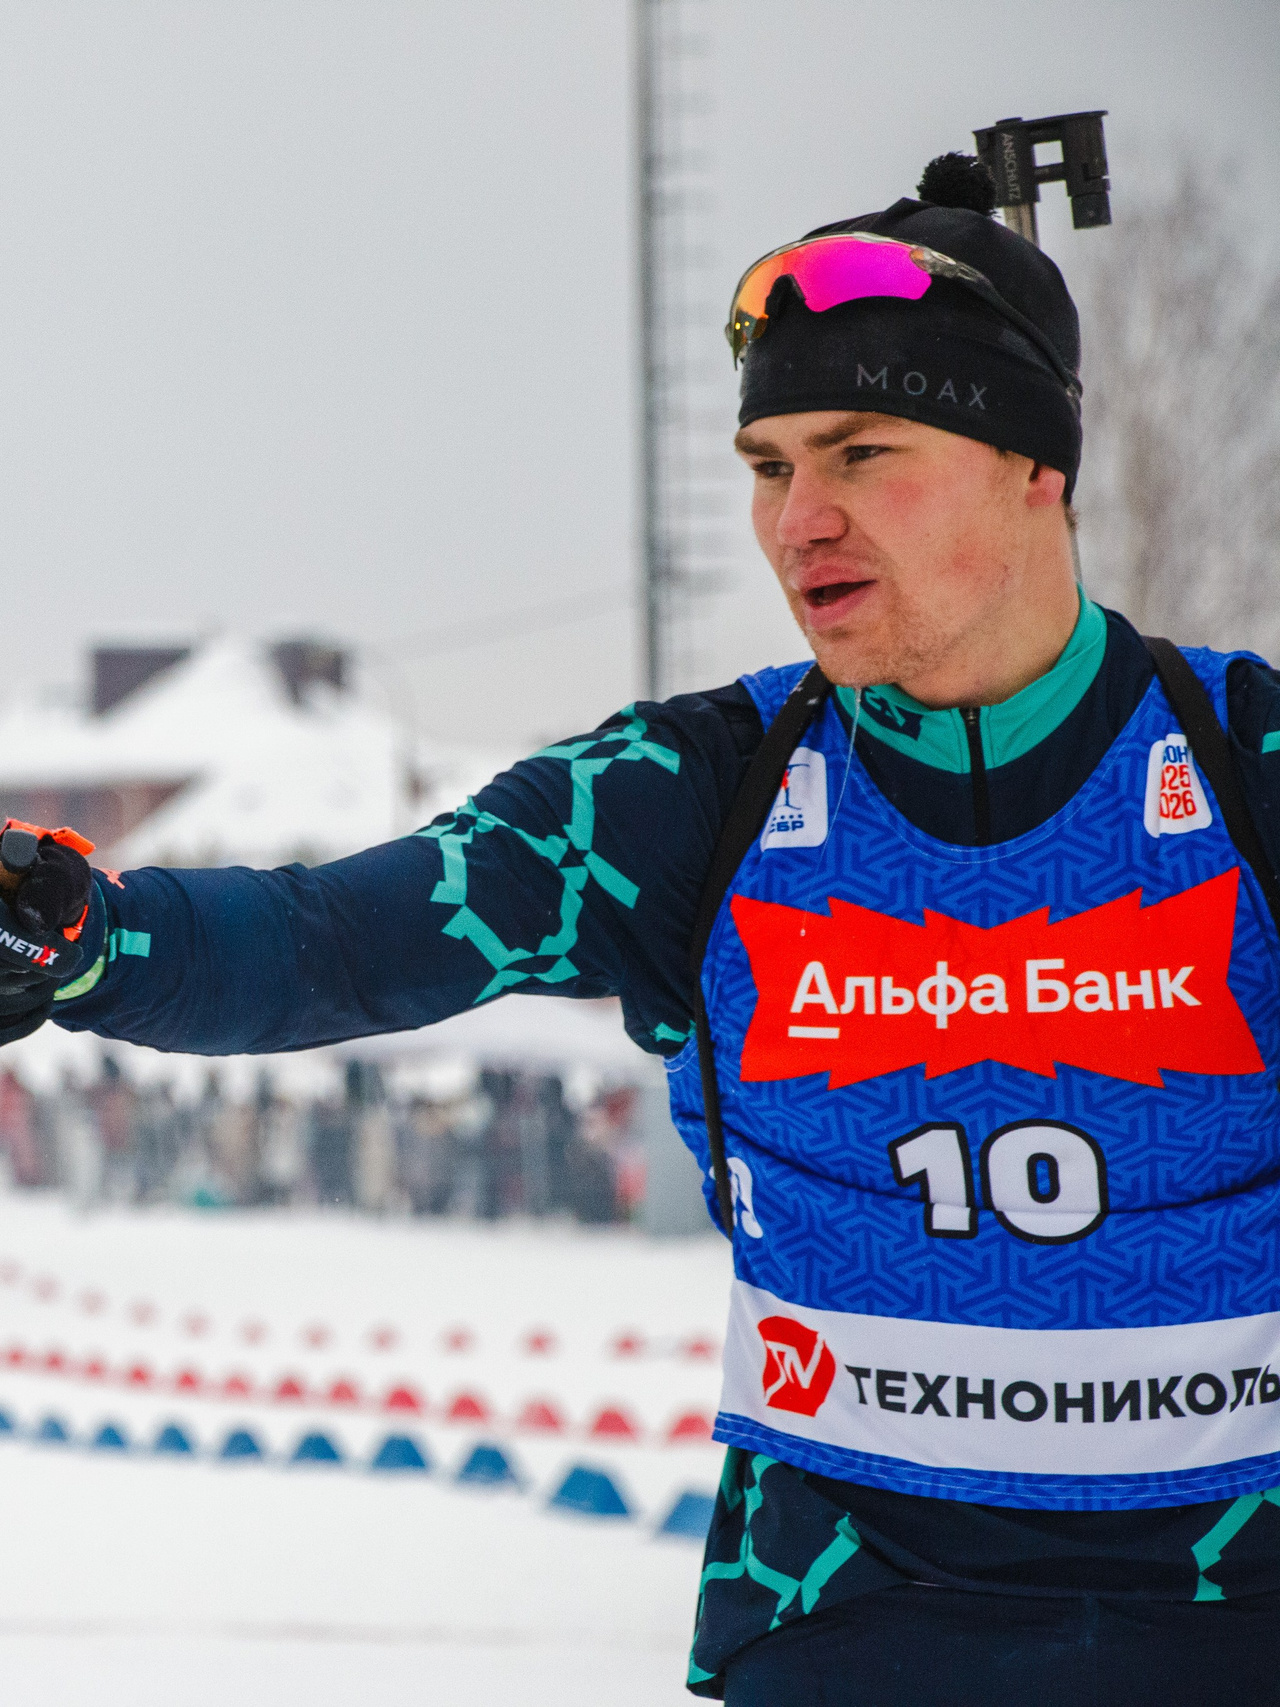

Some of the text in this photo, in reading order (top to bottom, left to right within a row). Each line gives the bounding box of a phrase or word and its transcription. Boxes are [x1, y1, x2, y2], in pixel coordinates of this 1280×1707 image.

[856, 363, 987, 410] MOAX
[787, 958, 1202, 1036] Альфа Банк
[887, 1119, 1110, 1245] 10
[844, 1362, 1280, 1424] ТЕХНОНИКОЛЬ
